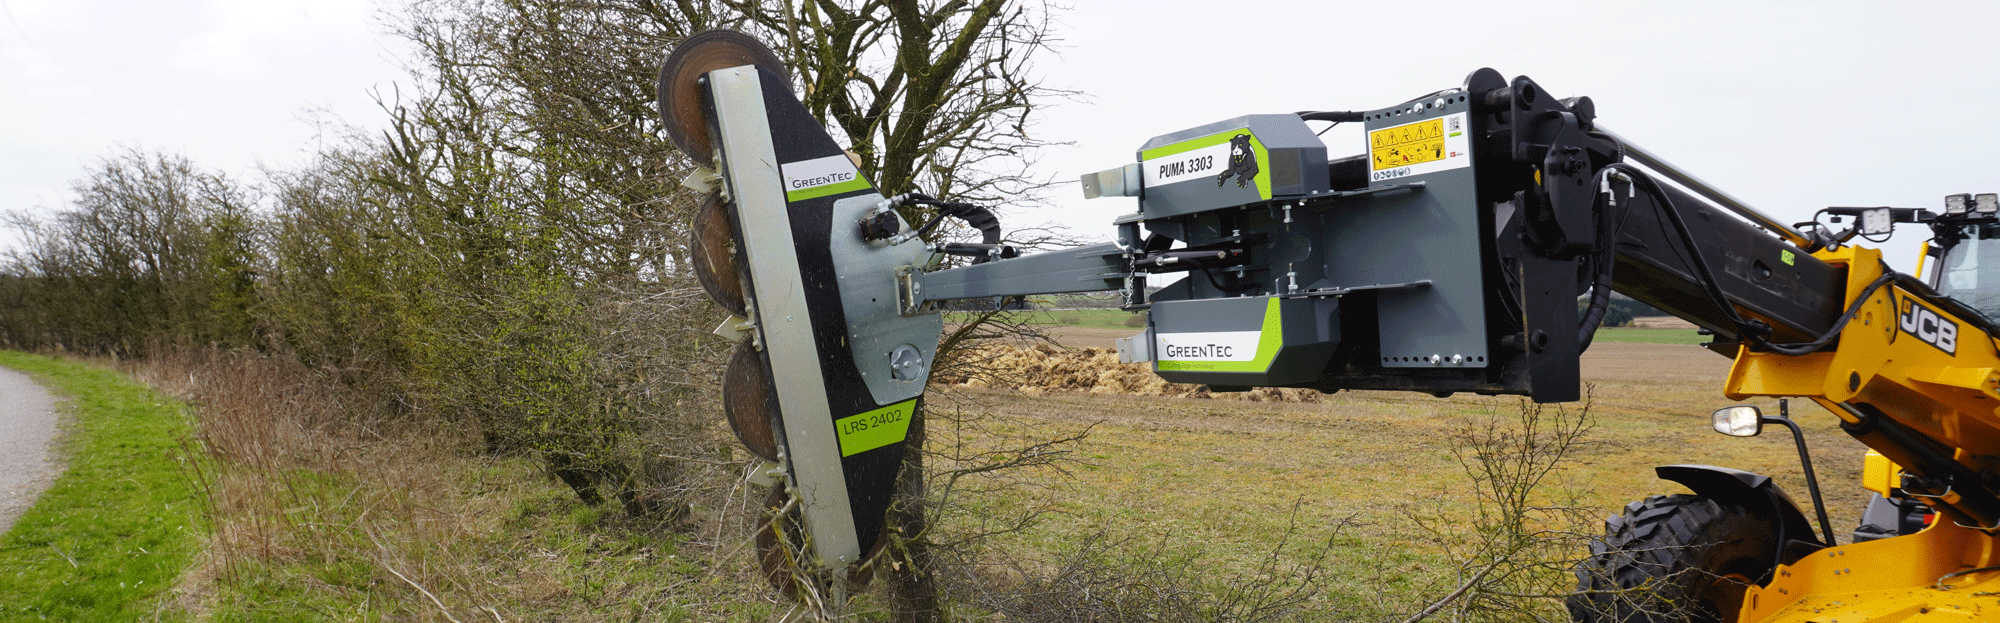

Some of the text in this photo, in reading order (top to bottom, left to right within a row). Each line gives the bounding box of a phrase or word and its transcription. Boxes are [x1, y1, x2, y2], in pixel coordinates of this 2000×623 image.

[1159, 155, 1213, 179] PUMA 3303
[1901, 304, 1957, 353] JCB
[843, 409, 903, 435] LRS 2402
